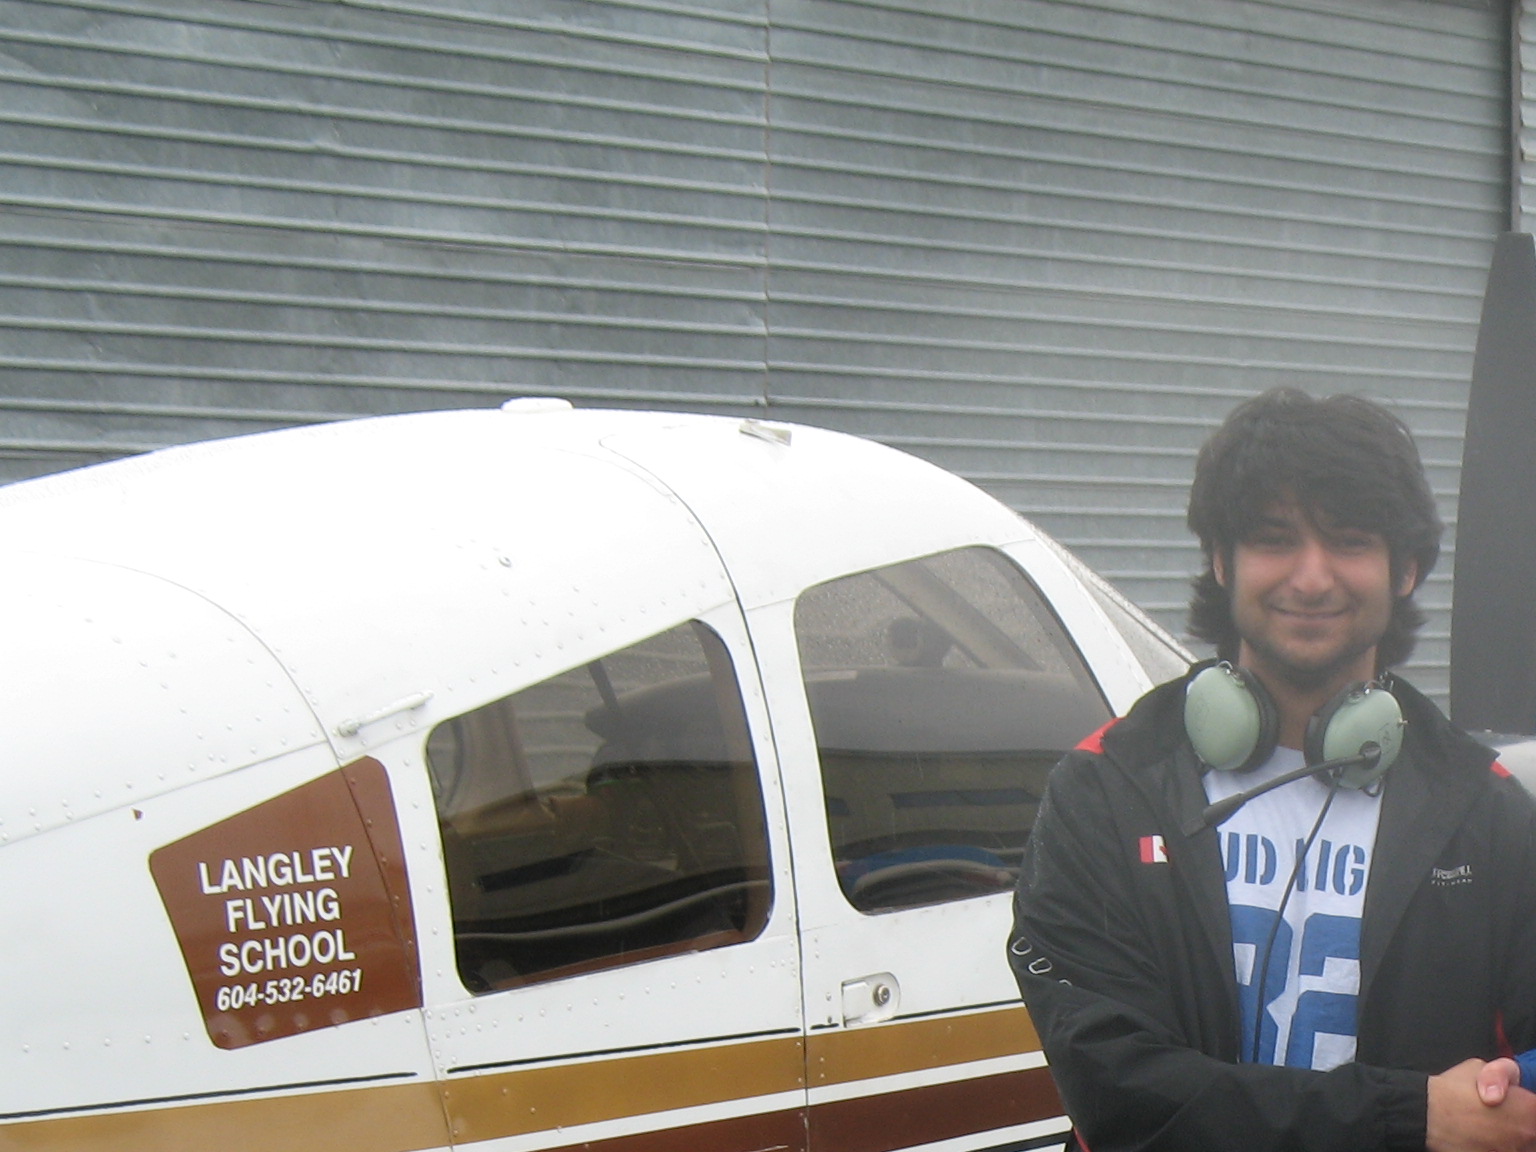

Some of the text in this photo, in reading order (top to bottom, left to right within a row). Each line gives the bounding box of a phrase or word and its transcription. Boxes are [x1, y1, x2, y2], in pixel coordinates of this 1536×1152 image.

[198, 845, 353, 895] LANGLEY
[226, 888, 341, 932] FLYING
[219, 929, 355, 977] SCHOOL
[216, 968, 362, 1010] 604-532-6461
